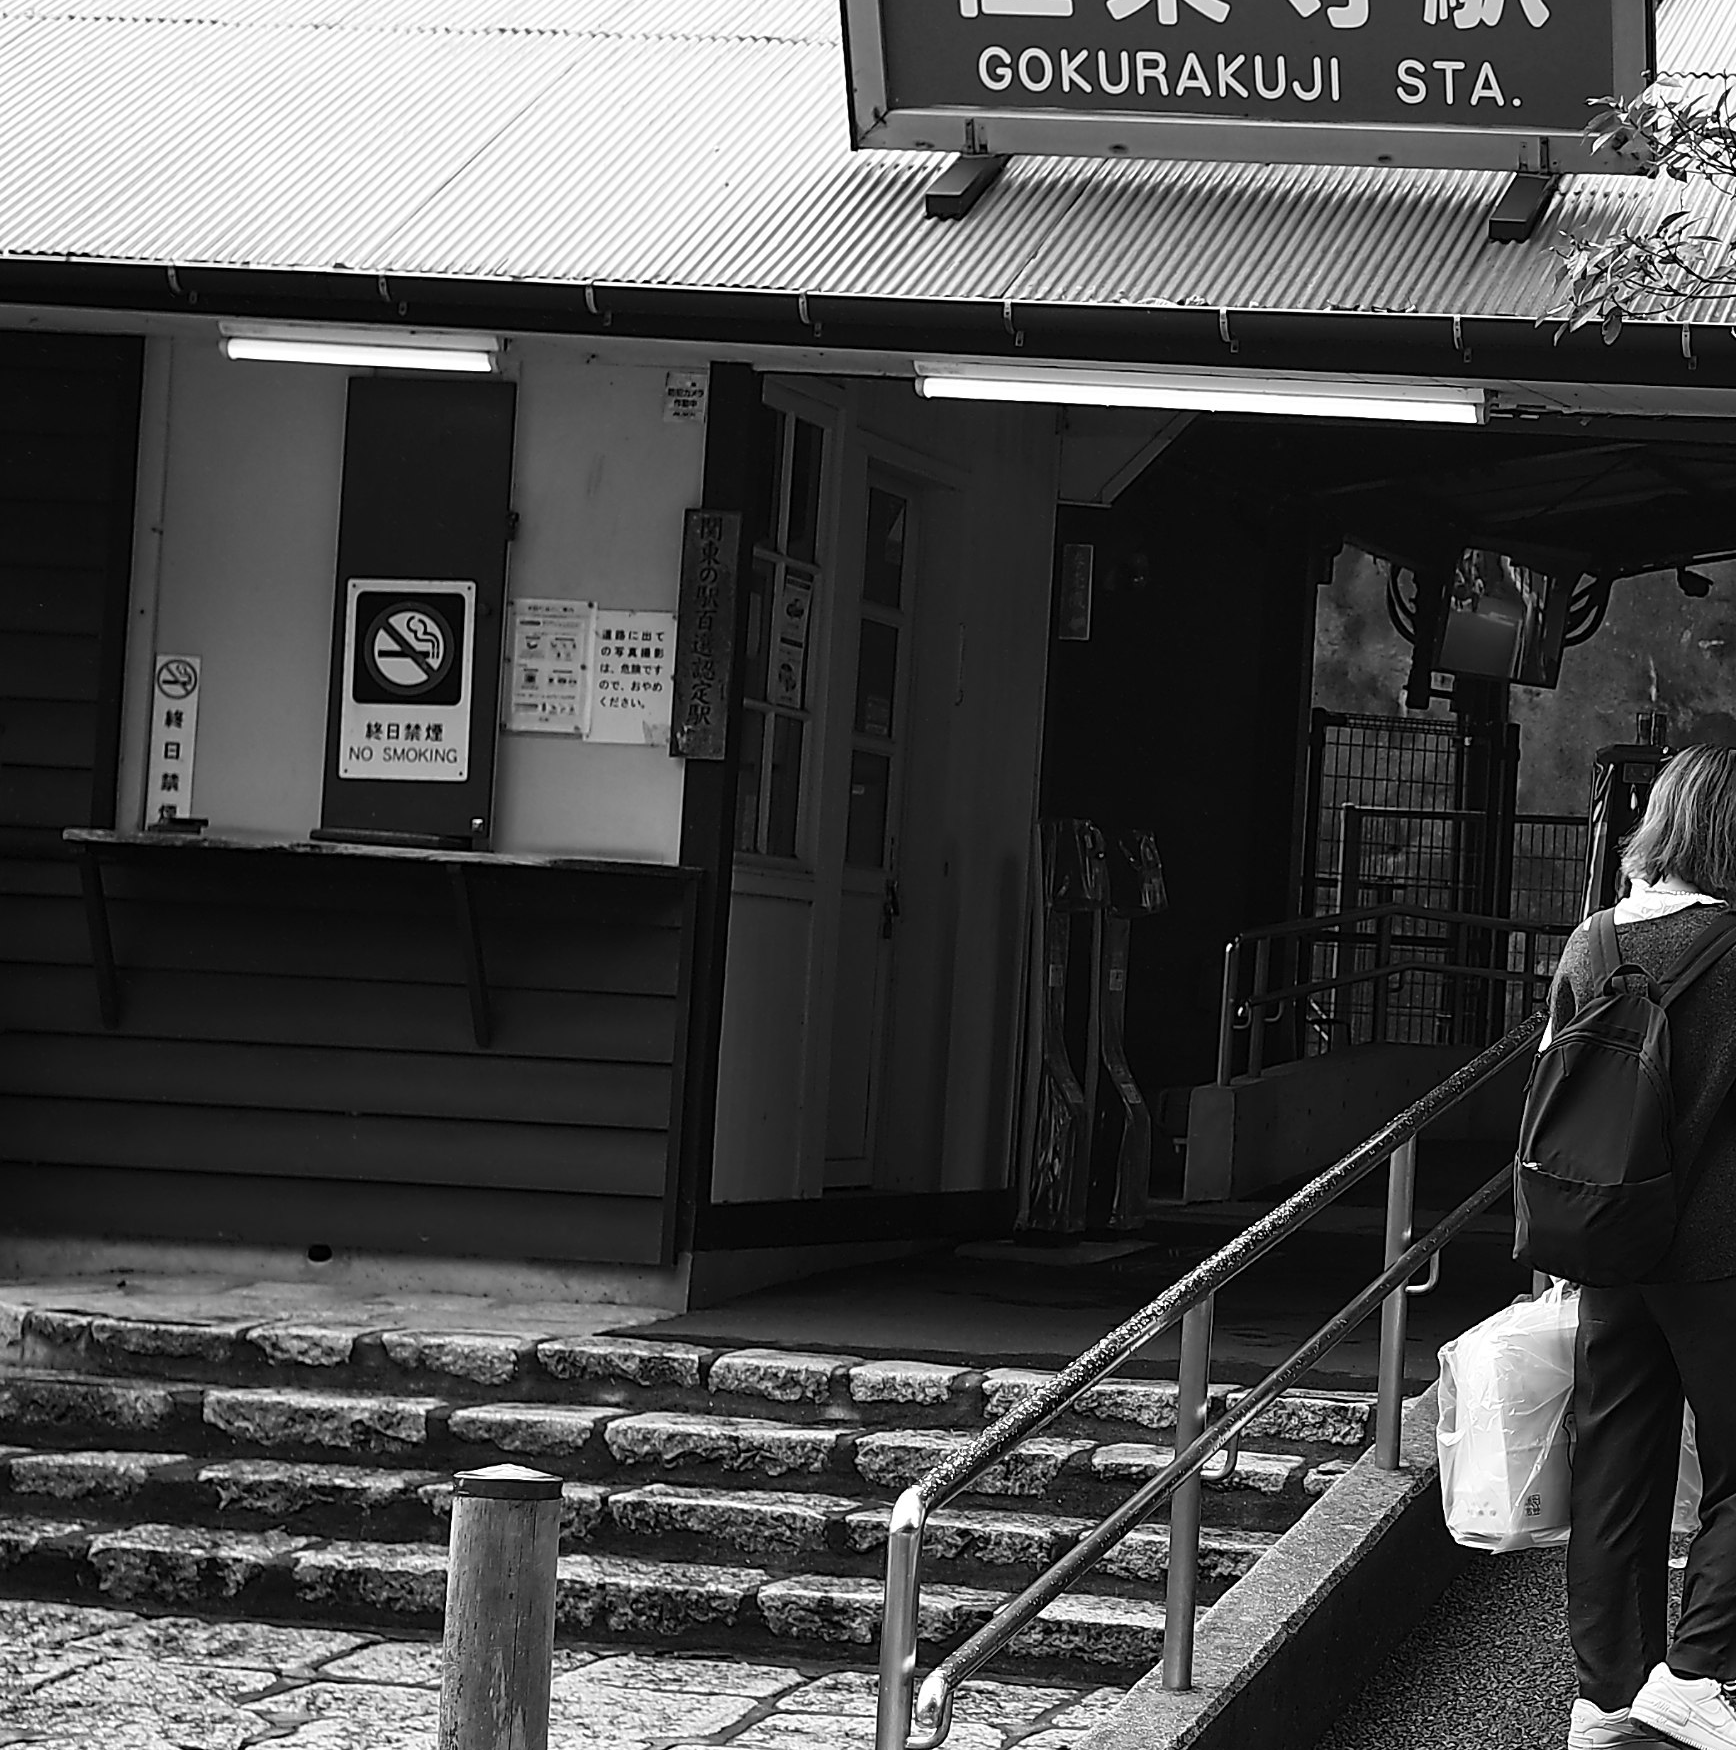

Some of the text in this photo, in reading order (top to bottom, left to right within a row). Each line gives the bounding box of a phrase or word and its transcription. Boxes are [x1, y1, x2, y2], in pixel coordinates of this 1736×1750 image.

[978, 45, 1524, 109] GOKURAKUJI STA.
[364, 721, 444, 743] 終日禁煙
[348, 745, 459, 764] NO SMOKING
